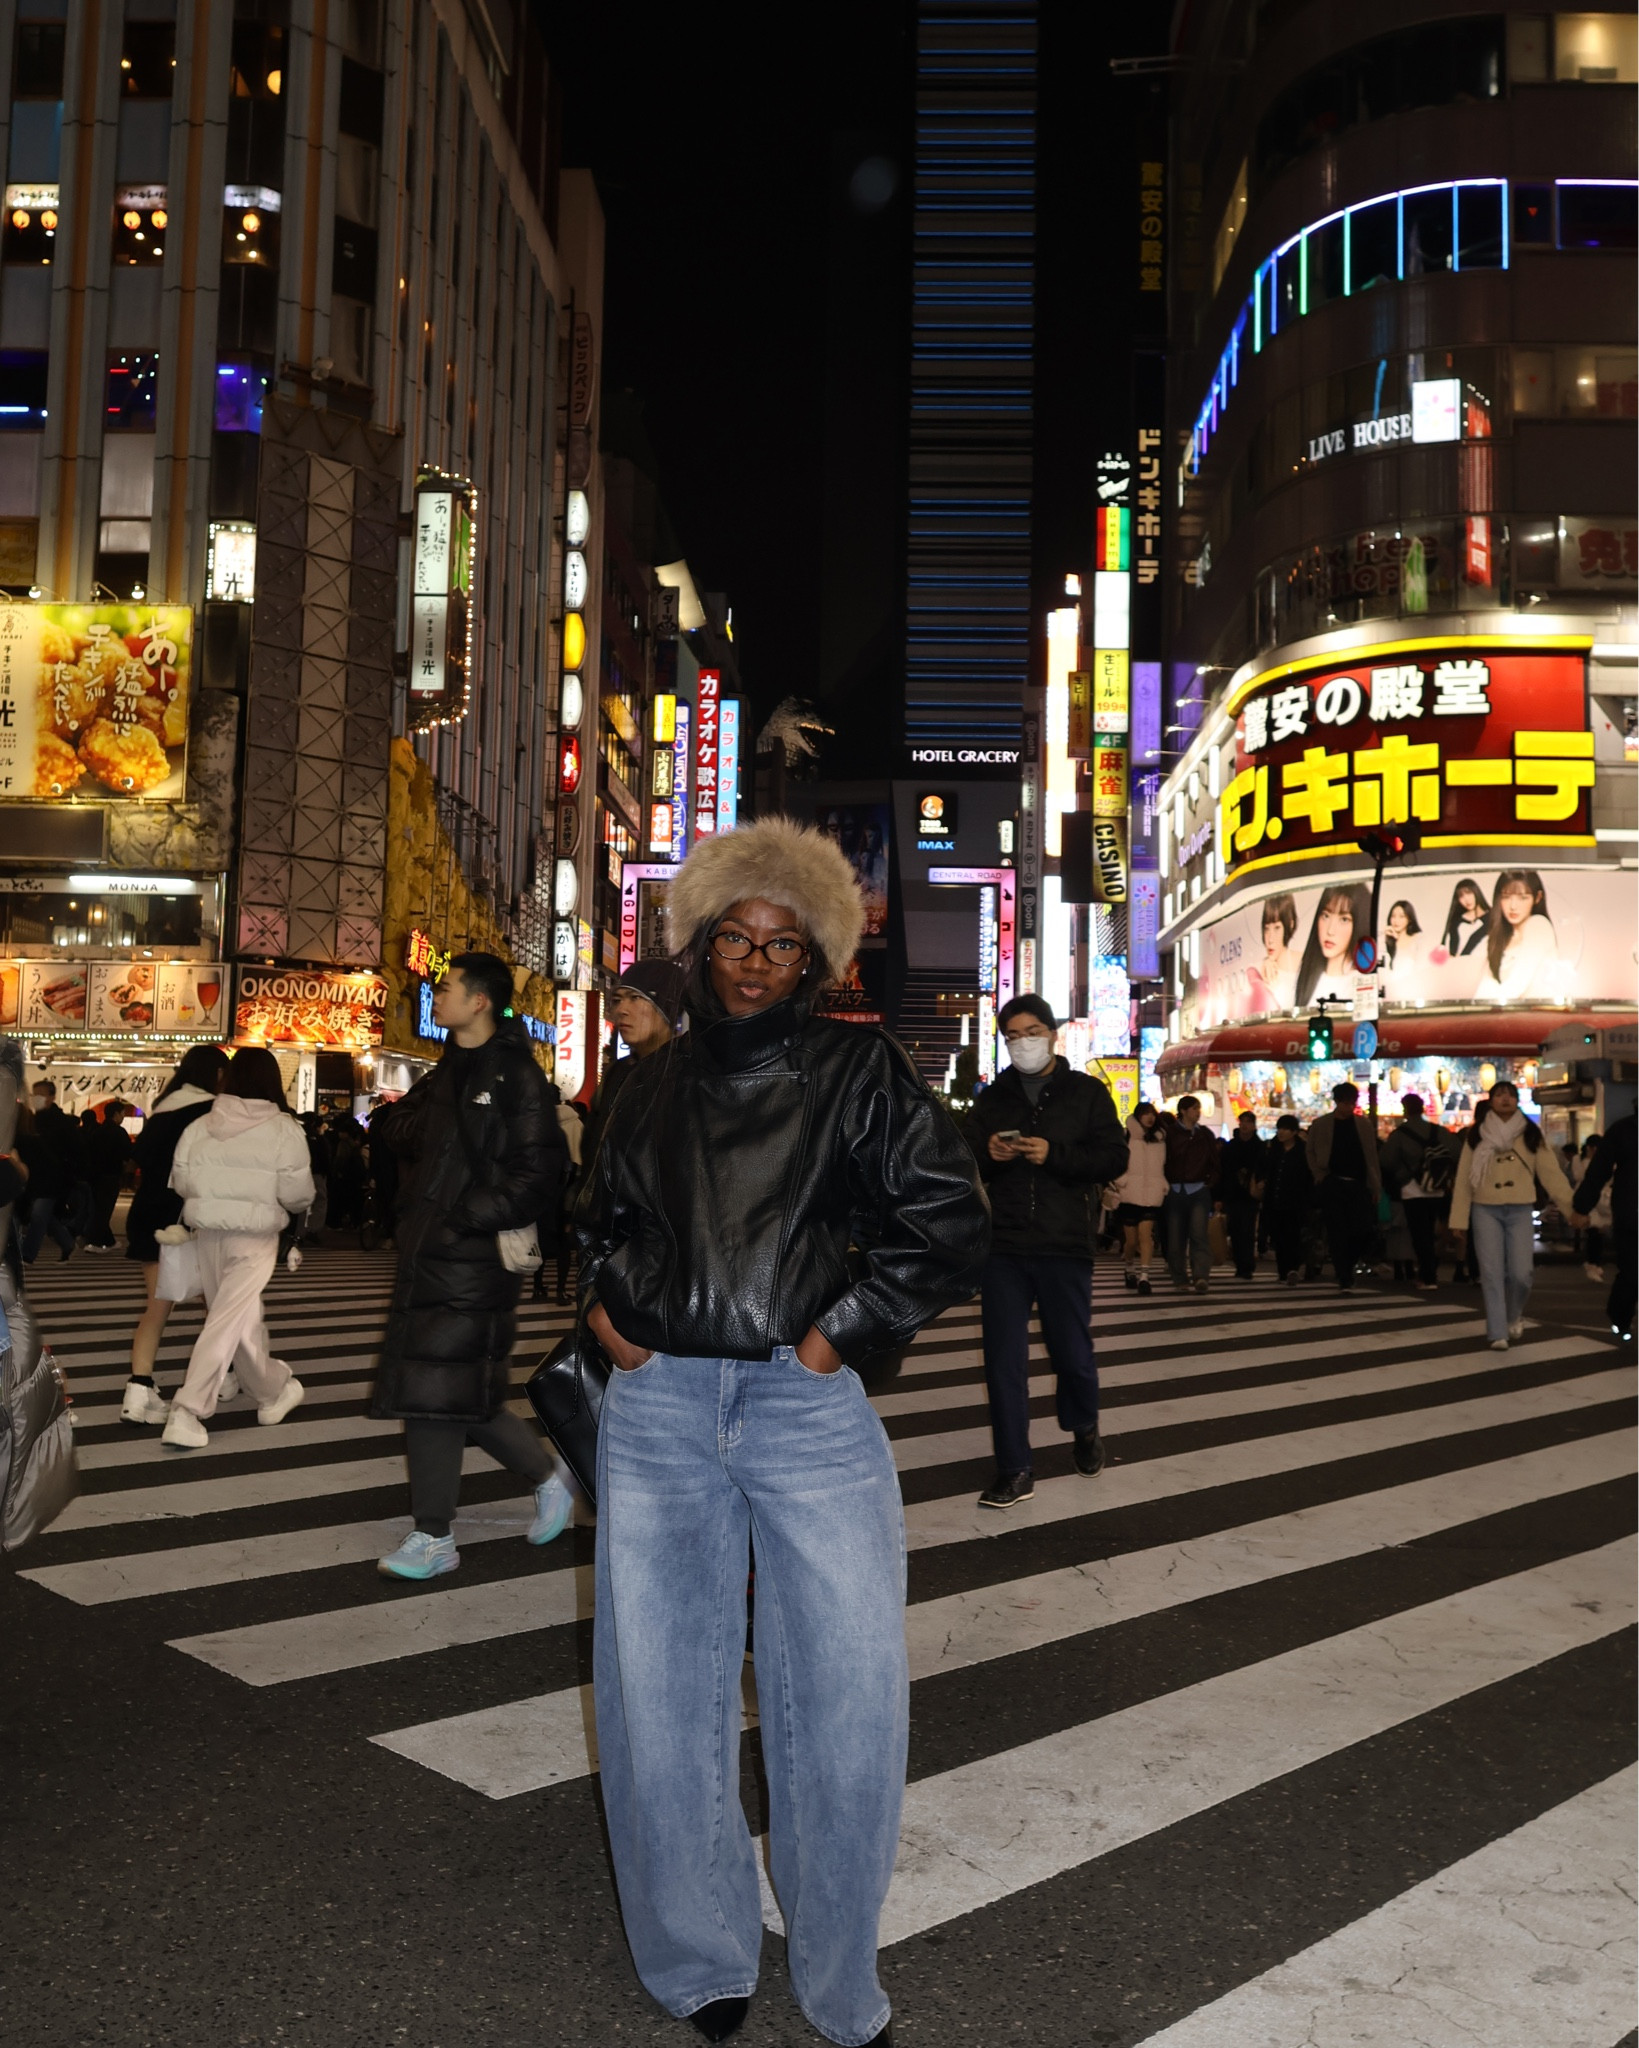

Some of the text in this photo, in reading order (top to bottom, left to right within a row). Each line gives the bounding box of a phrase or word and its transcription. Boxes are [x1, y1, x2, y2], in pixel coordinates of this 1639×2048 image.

[1309, 413, 1412, 461] LIVE HOUSE
[1579, 529, 1638, 573] 免
[223, 572, 244, 595] 光
[420, 659, 436, 676] 光
[1103, 653, 1115, 697] 生ビール
[112, 662, 147, 738] 猛烈に
[1097, 702, 1126, 711] 199円
[1243, 660, 1490, 753] 驚安の殿堂
[696, 675, 718, 833] カラオケ歌広場
[912, 750, 1020, 763] HOTEL GRACERY
[1101, 735, 1121, 747] 4F
[1099, 752, 1123, 796] 麻雀
[917, 841, 954, 850] IMAX
[1095, 823, 1126, 897] CASINO
[109, 883, 158, 892] MONJA
[932, 871, 1002, 880] CENTRAL ROAD
[1023, 893, 1035, 929] Booth
[1001, 920, 1014, 988] ゴジラ
[27, 968, 44, 1024] うな丼
[91, 968, 108, 1026] おつまみ
[160, 983, 176, 1011] お酒
[241, 977, 388, 1008] OKONOMIYAKI
[247, 1001, 374, 1034] お好み焼き
[559, 997, 574, 1060] トラノコ
[1285, 1041, 1309, 1055] Do
[1105, 1063, 1136, 1072] カラオケ
